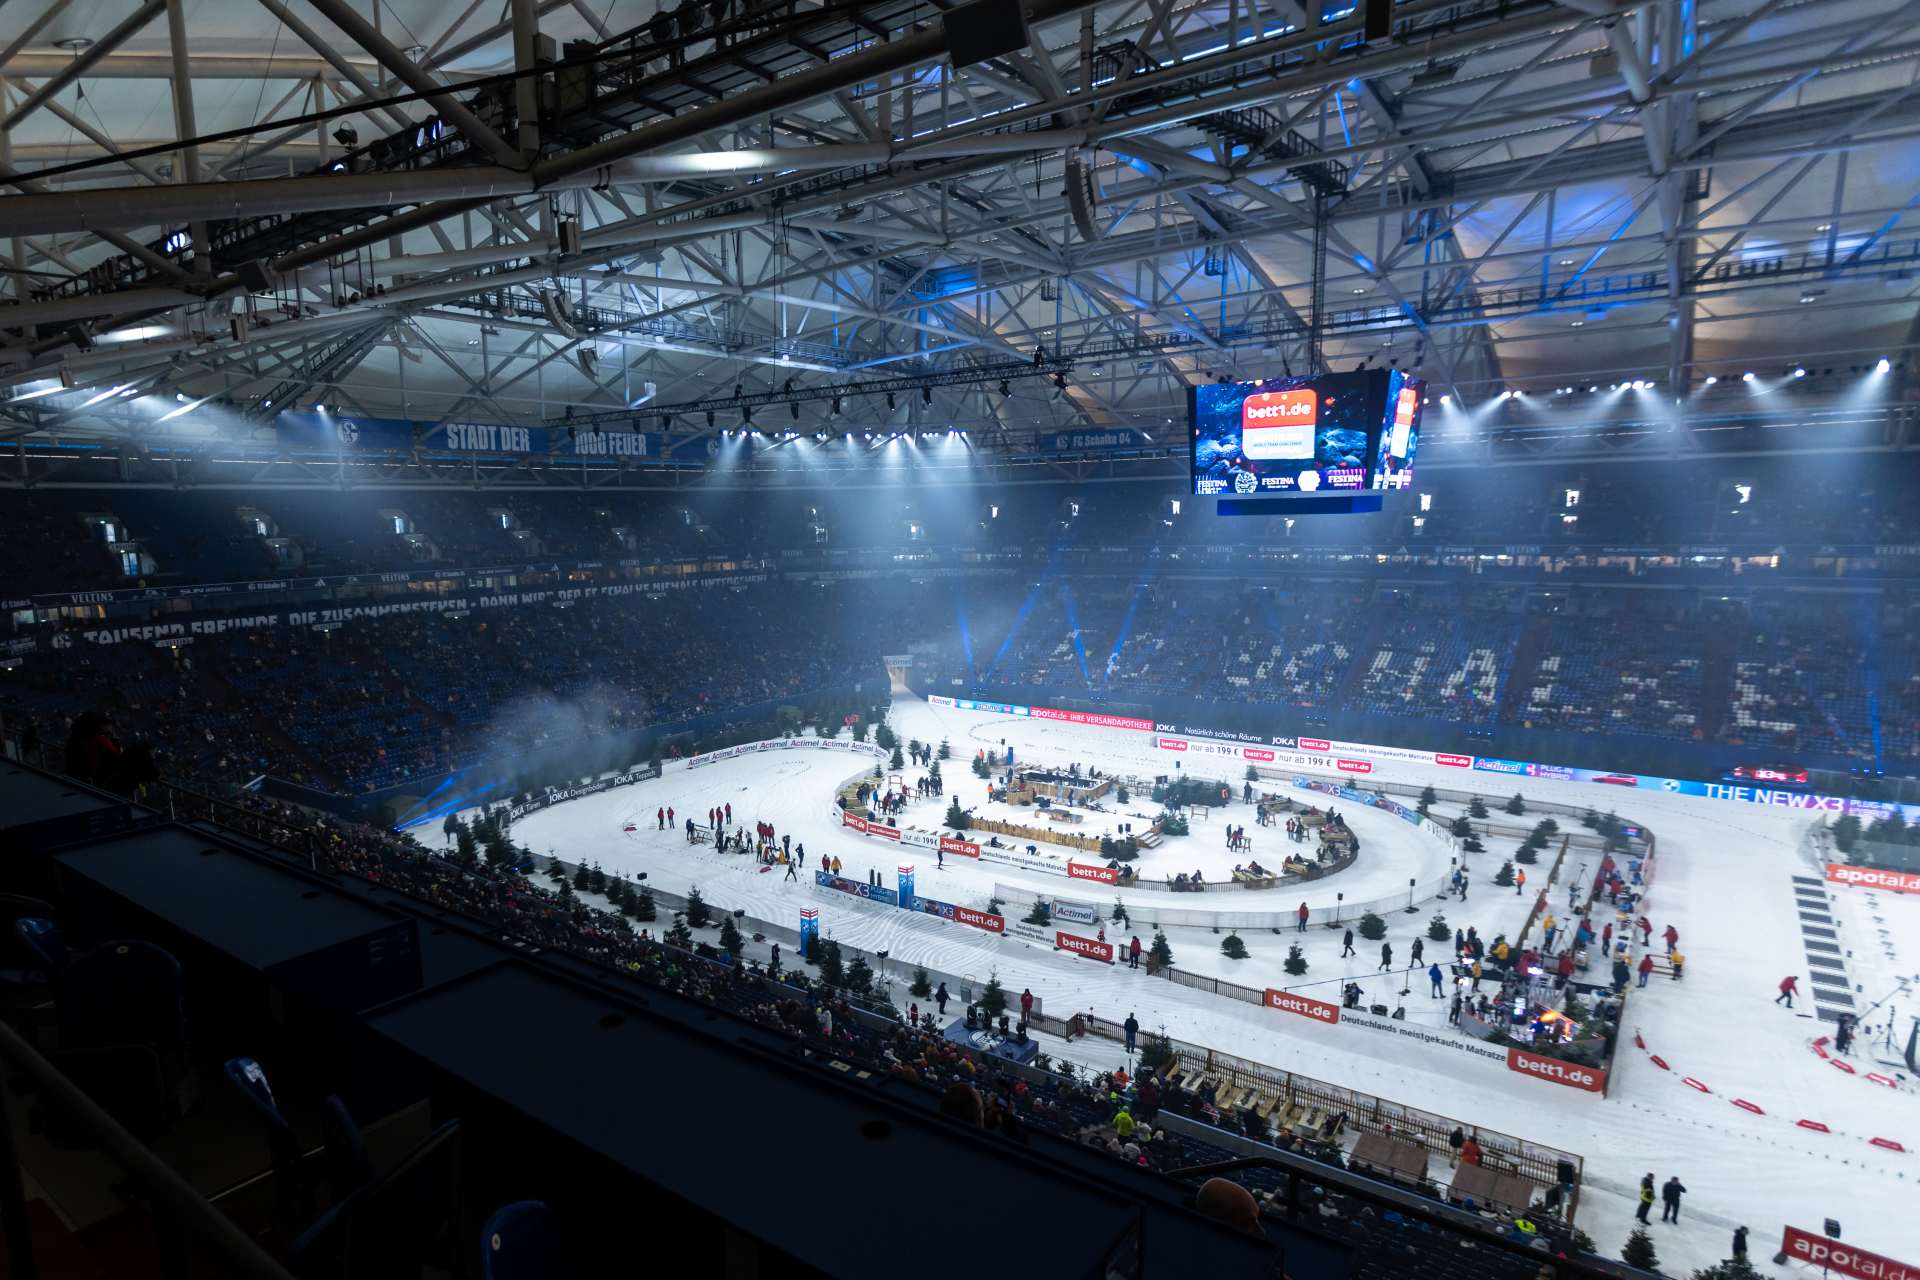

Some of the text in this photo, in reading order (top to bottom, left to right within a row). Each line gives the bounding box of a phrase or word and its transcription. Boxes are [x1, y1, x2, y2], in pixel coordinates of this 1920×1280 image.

[1247, 402, 1312, 419] bett1.de
[446, 424, 530, 452] STADT DER
[608, 432, 647, 456] FEUER
[1261, 477, 1295, 486] FESTINA
[1328, 475, 1363, 483] FESTINA
[71, 592, 114, 604] VELTINS
[1030, 709, 1067, 719] apotal.de
[1070, 714, 1086, 722] IHRE
[1086, 716, 1153, 730] VERSANDAPOTHEKE
[1156, 723, 1176, 733] JOKA
[1185, 727, 1262, 742] Natürlich schöne Räume
[760, 740, 788, 750] Actimel
[791, 739, 819, 747] Actimel
[822, 740, 849, 748] Actimel
[851, 742, 874, 751] Actimel
[1272, 736, 1295, 746] JOKA
[1301, 740, 1329, 749] bett1.de
[735, 744, 758, 754] Actimel
[1161, 741, 1186, 749] bett1.de
[1191, 744, 1203, 752] nur
[1204, 744, 1215, 753] ab
[1217, 746, 1231, 755] 199
[688, 755, 711, 767] Actimel
[712, 750, 734, 760] Actimel
[1245, 751, 1273, 759] bett1.de
[1279, 754, 1292, 762] nur
[1295, 755, 1305, 764] ab
[1308, 758, 1324, 766] 199
[1436, 755, 1469, 765] bett1.de
[1339, 761, 1370, 770] bett1.de
[1475, 758, 1521, 773] Actimel
[1540, 764, 1574, 774] PLUG-IN
[614, 770, 656, 786] JOKA Teppich
[1540, 771, 1570, 781] HYBRID
[1327, 784, 1341, 796] X3
[550, 791, 569, 805] JOKA
[1704, 783, 1845, 812] THE NEW X3
[510, 806, 525, 821] JOKA
[1392, 806, 1403, 817] X3
[845, 816, 865, 829] bett1.de
[944, 842, 976, 854] bett1.de
[1072, 866, 1112, 880] bett1.de
[854, 885, 870, 898] X3
[870, 886, 893, 897] PLUG-IN
[870, 893, 889, 902] HYBRID
[943, 905, 954, 917] X3
[1056, 906, 1093, 920] Actimel
[960, 911, 999, 928] bett1.de
[1062, 936, 1107, 956] bett1.de
[1272, 994, 1331, 1018] bett1.de
[1341, 1014, 1506, 1062] Deutschlands meistgekaufte Matratze
[1517, 1055, 1593, 1085] bett1.de
[1794, 1239, 1920, 1280] apotal.d
